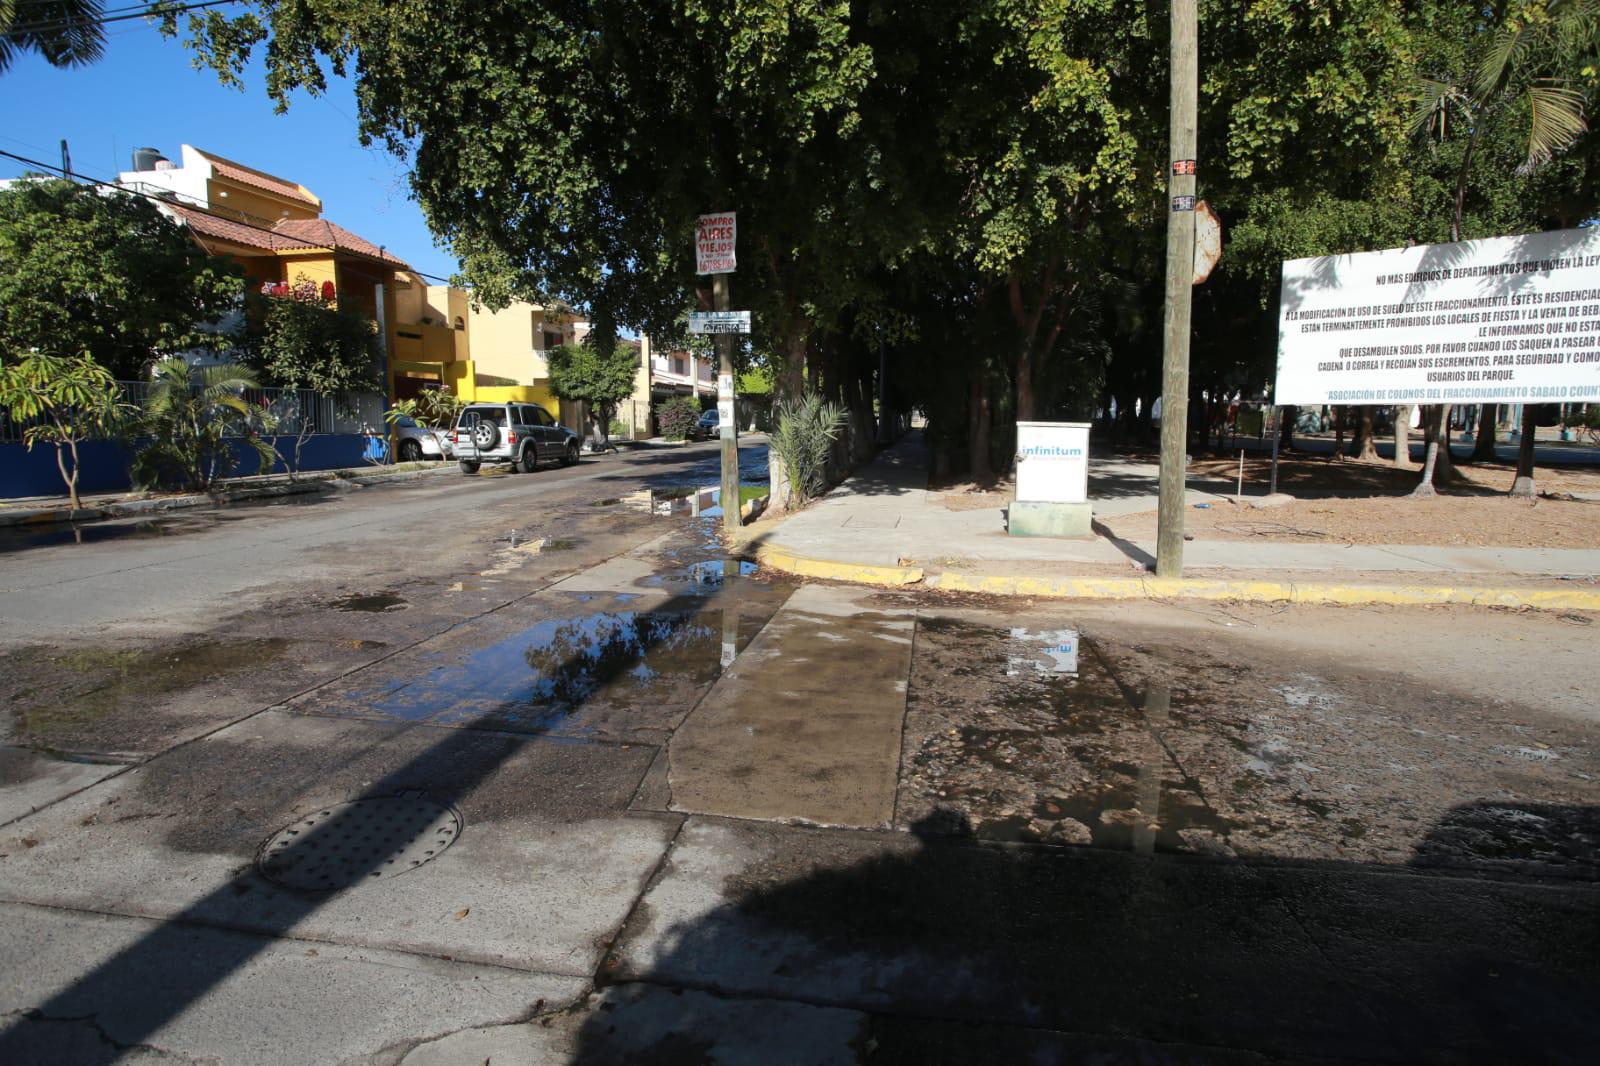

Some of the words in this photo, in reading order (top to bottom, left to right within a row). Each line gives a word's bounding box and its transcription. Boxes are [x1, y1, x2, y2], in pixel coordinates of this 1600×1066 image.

[698, 217, 734, 226] OMPRO
[699, 227, 733, 241] AIRES
[699, 242, 734, 253] VIEJOS
[1376, 275, 1386, 285] NO
[1387, 274, 1403, 284] MAS
[1405, 270, 1440, 283] EDIFICIOS
[1442, 269, 1452, 279] DE
[1453, 263, 1521, 278] DEPARTAMENTOS
[1522, 261, 1539, 272] QUE
[1541, 259, 1571, 271] VIOLEN
[1572, 257, 1583, 268] LA
[1585, 255, 1600, 267] LEY
[1291, 311, 1298, 320] LA
[1347, 307, 1356, 317] DE
[1357, 306, 1371, 316] USO
[1372, 305, 1381, 315] DE
[1382, 303, 1404, 314] SUELO
[1405, 303, 1414, 313] DE
[1416, 301, 1433, 312] ESTE
[1533, 293, 1543, 304] ES
[1322, 319, 1384, 332] TERMINANTEMENTE
[1386, 316, 1430, 328] PROHIBIDOS
[1432, 315, 1446, 326] LOS
[1447, 312, 1480, 325] LOCALES
[1481, 312, 1492, 322] DE
[1493, 310, 1519, 322] FIESTA
[1521, 310, 1527, 320] Y
[1528, 309, 1538, 319] LA
[1540, 307, 1566, 319] VENTA
[1568, 306, 1579, 317] DE
[1581, 305, 1600, 316] BEB
[1479, 327, 1487, 337] LE
[1488, 323, 1544, 337] INFORMAMOS
[1546, 322, 1563, 334] QUE
[1565, 322, 1577, 333] NO
[1339, 348, 1352, 358] QUE
[1353, 346, 1398, 358] DESAMBULEN
[1425, 344, 1441, 354] POR
[1442, 342, 1466, 353] FAVOR
[1468, 340, 1500, 352] CUANDO
[1502, 340, 1517, 351] LOS
[1519, 338, 1552, 351] SAQUEN
[1553, 338, 1560, 348] A
[1561, 336, 1596, 348] PASEAR
[1318, 361, 1343, 372] CADENA
[1346, 361, 1351, 370] O
[1352, 360, 1378, 370] CORREA
[1380, 360, 1385, 369] Y
[1418, 358, 1433, 368] SUS
[1493, 355, 1514, 366] PARA
[1515, 353, 1564, 365] SEGURIDAD
[1566, 353, 1571, 363] Y
[1427, 371, 1465, 382] USUARIOS
[1467, 370, 1480, 381] DEL
[1376, 389, 1386, 399] DE
[1388, 388, 1425, 399] COLONOS
[1427, 388, 1441, 398] DEL
[1443, 387, 1528, 398] FRACCIONAMIENTO
[1529, 386, 1567, 397] SABALO
[1022, 445, 1081, 456] infinitum
